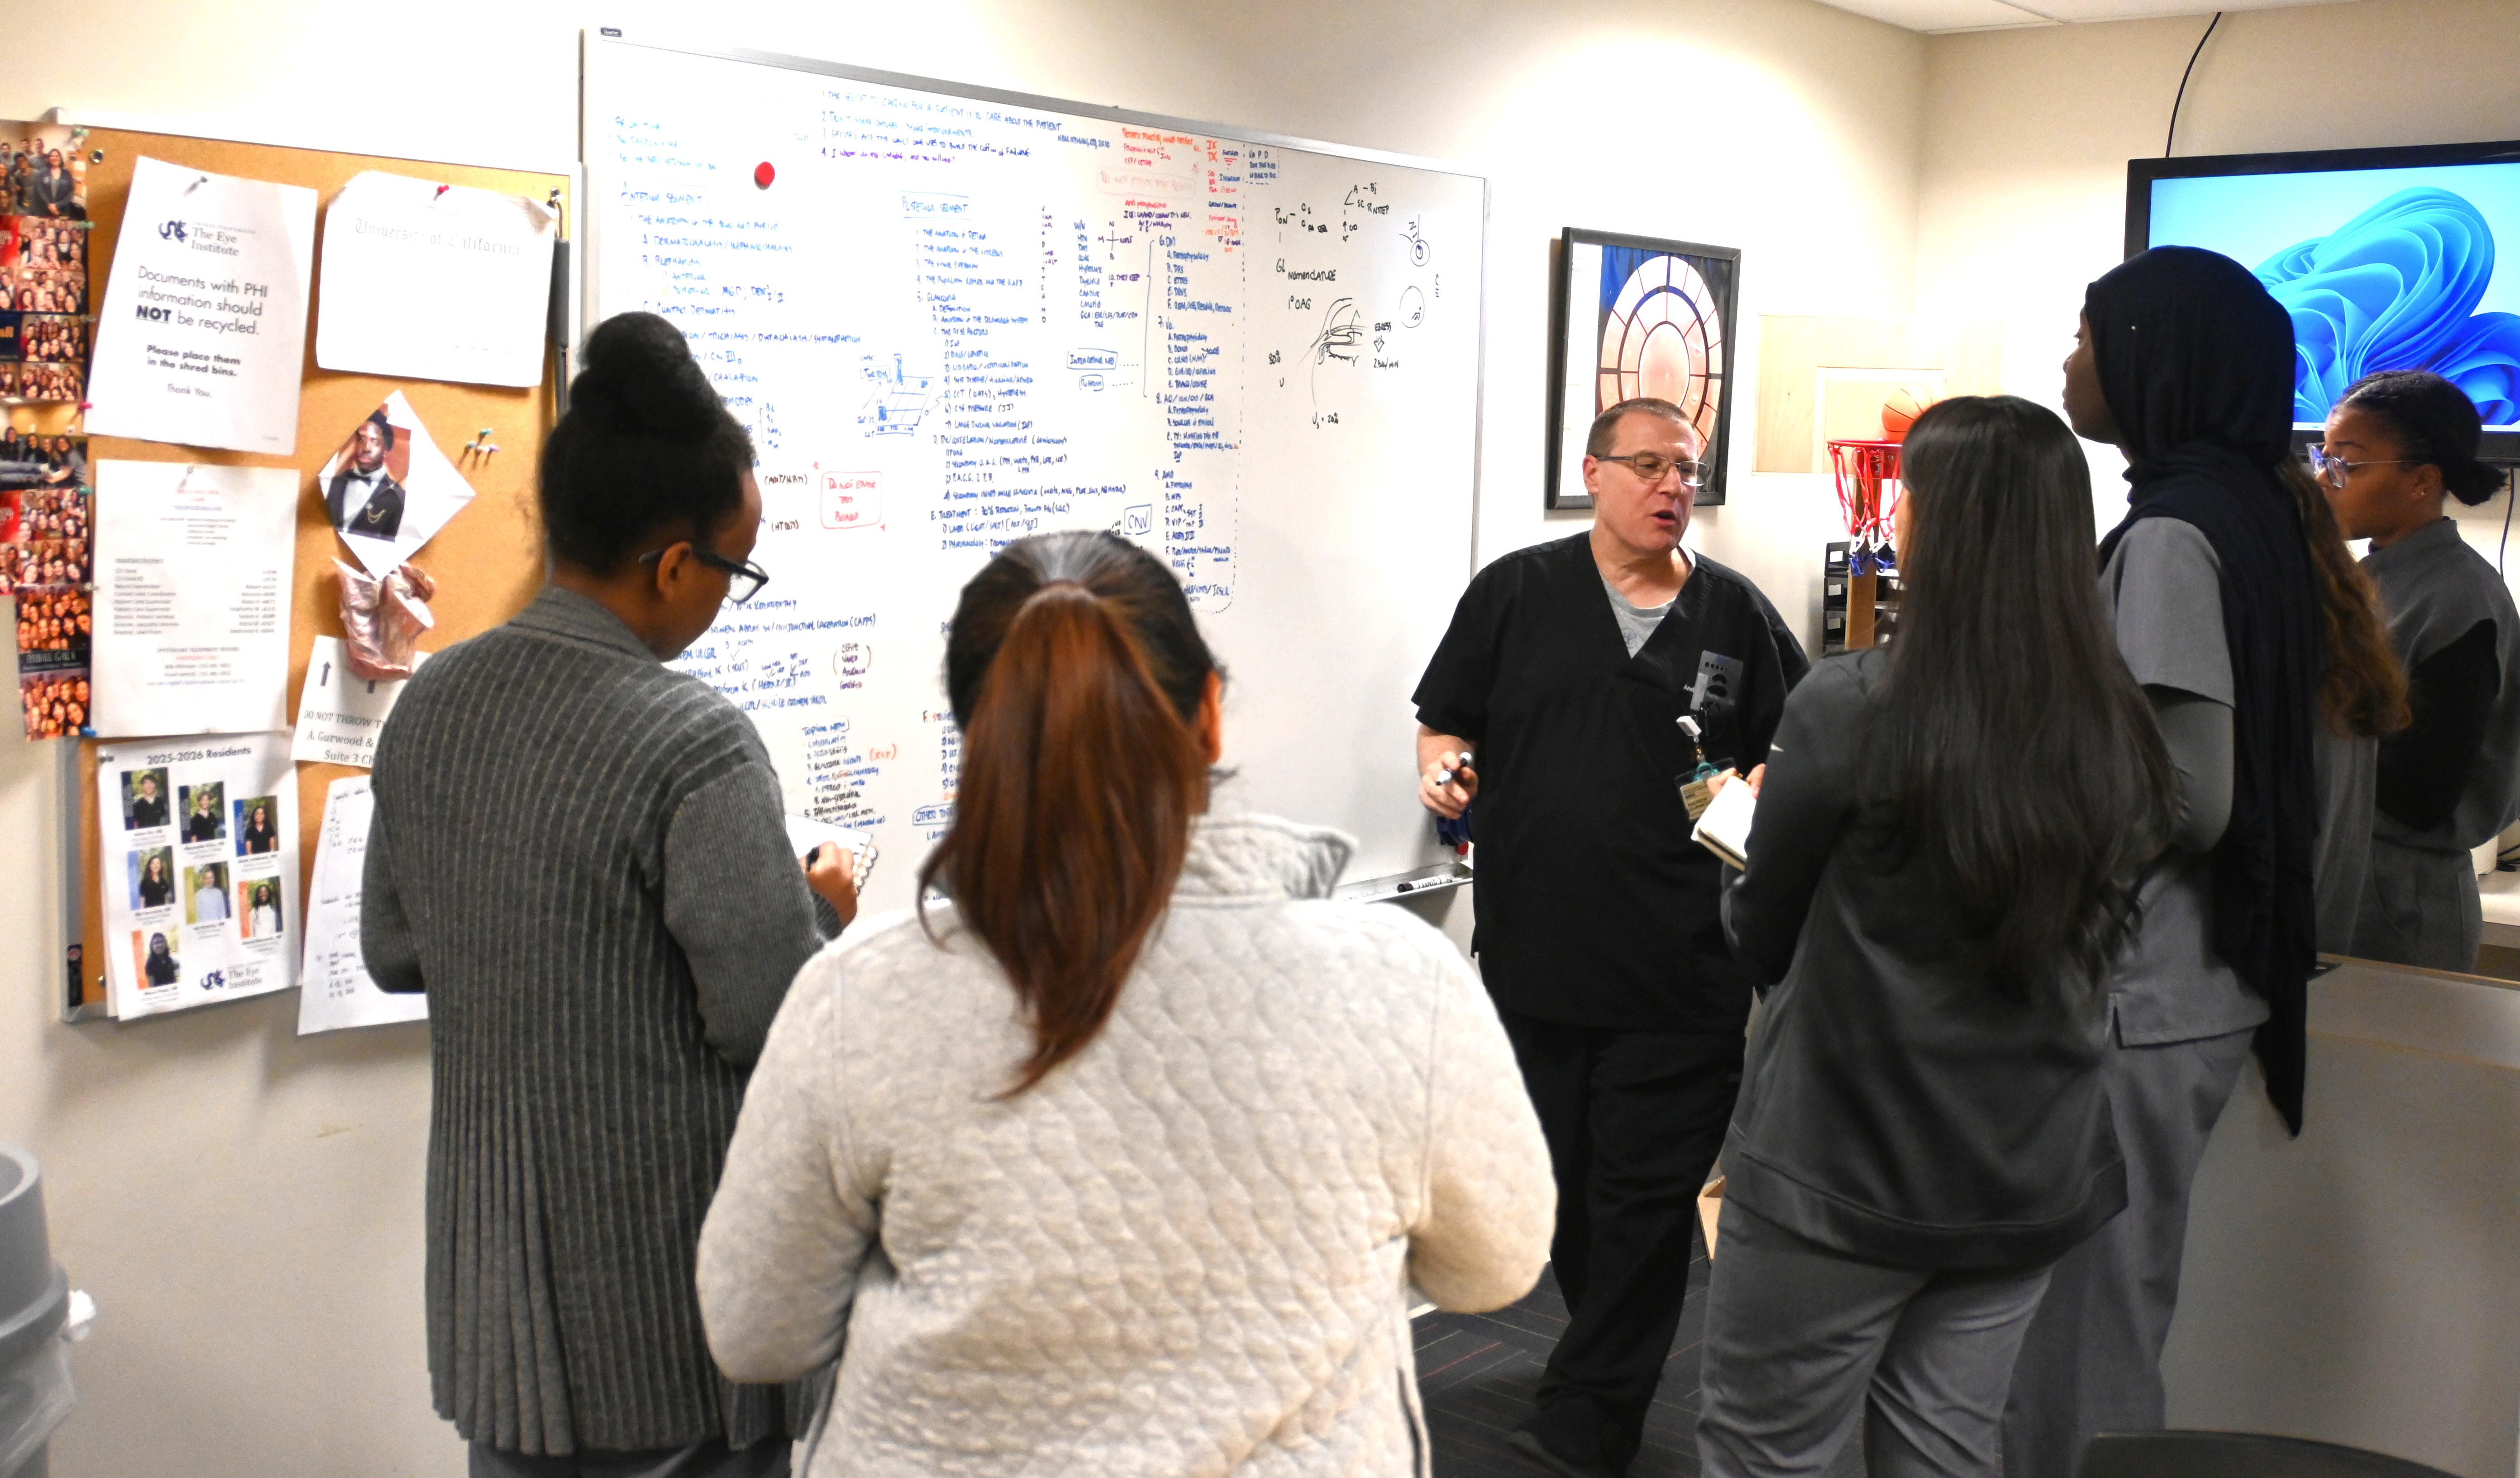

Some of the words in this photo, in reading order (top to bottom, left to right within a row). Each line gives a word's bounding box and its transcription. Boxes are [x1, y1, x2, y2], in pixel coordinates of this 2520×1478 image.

[986, 112, 1001, 121] CARE
[1005, 116, 1021, 124] ABOUT
[1023, 119, 1033, 128] THE
[1036, 120, 1062, 131] PATIENT
[194, 227, 213, 239] The
[217, 231, 237, 244] Eye
[191, 239, 240, 256] Institute
[138, 265, 205, 289] Documents
[210, 279, 239, 294] with
[244, 282, 268, 298] PHI
[138, 286, 212, 309] information
[217, 297, 263, 316] should
[136, 305, 172, 322] NOT
[177, 309, 194, 325] be
[199, 318, 260, 335] recycled.
[147, 344, 179, 357] Please
[182, 350, 210, 361] place
[213, 354, 241, 365] them
[147, 357, 157, 366] in
[159, 358, 176, 368] the
[179, 362, 209, 373] shred
[211, 365, 237, 377] bins.
[167, 383, 191, 395] Thank
[827, 477, 837, 490] DO
[840, 480, 853, 489] NOT
[835, 511, 859, 522] BOARD
[1128, 511, 1149, 530] CNV
[317, 711, 334, 722] NOT
[336, 714, 372, 727] THROW
[318, 732, 362, 746] Gurwood
[365, 738, 373, 748] &
[146, 751, 203, 765] 2025-2026
[206, 746, 251, 759] Residents
[324, 750, 349, 762] Suite
[352, 753, 358, 763] 3
[229, 968, 244, 979] The
[246, 967, 259, 978] Eye
[228, 977, 262, 990] Institute
